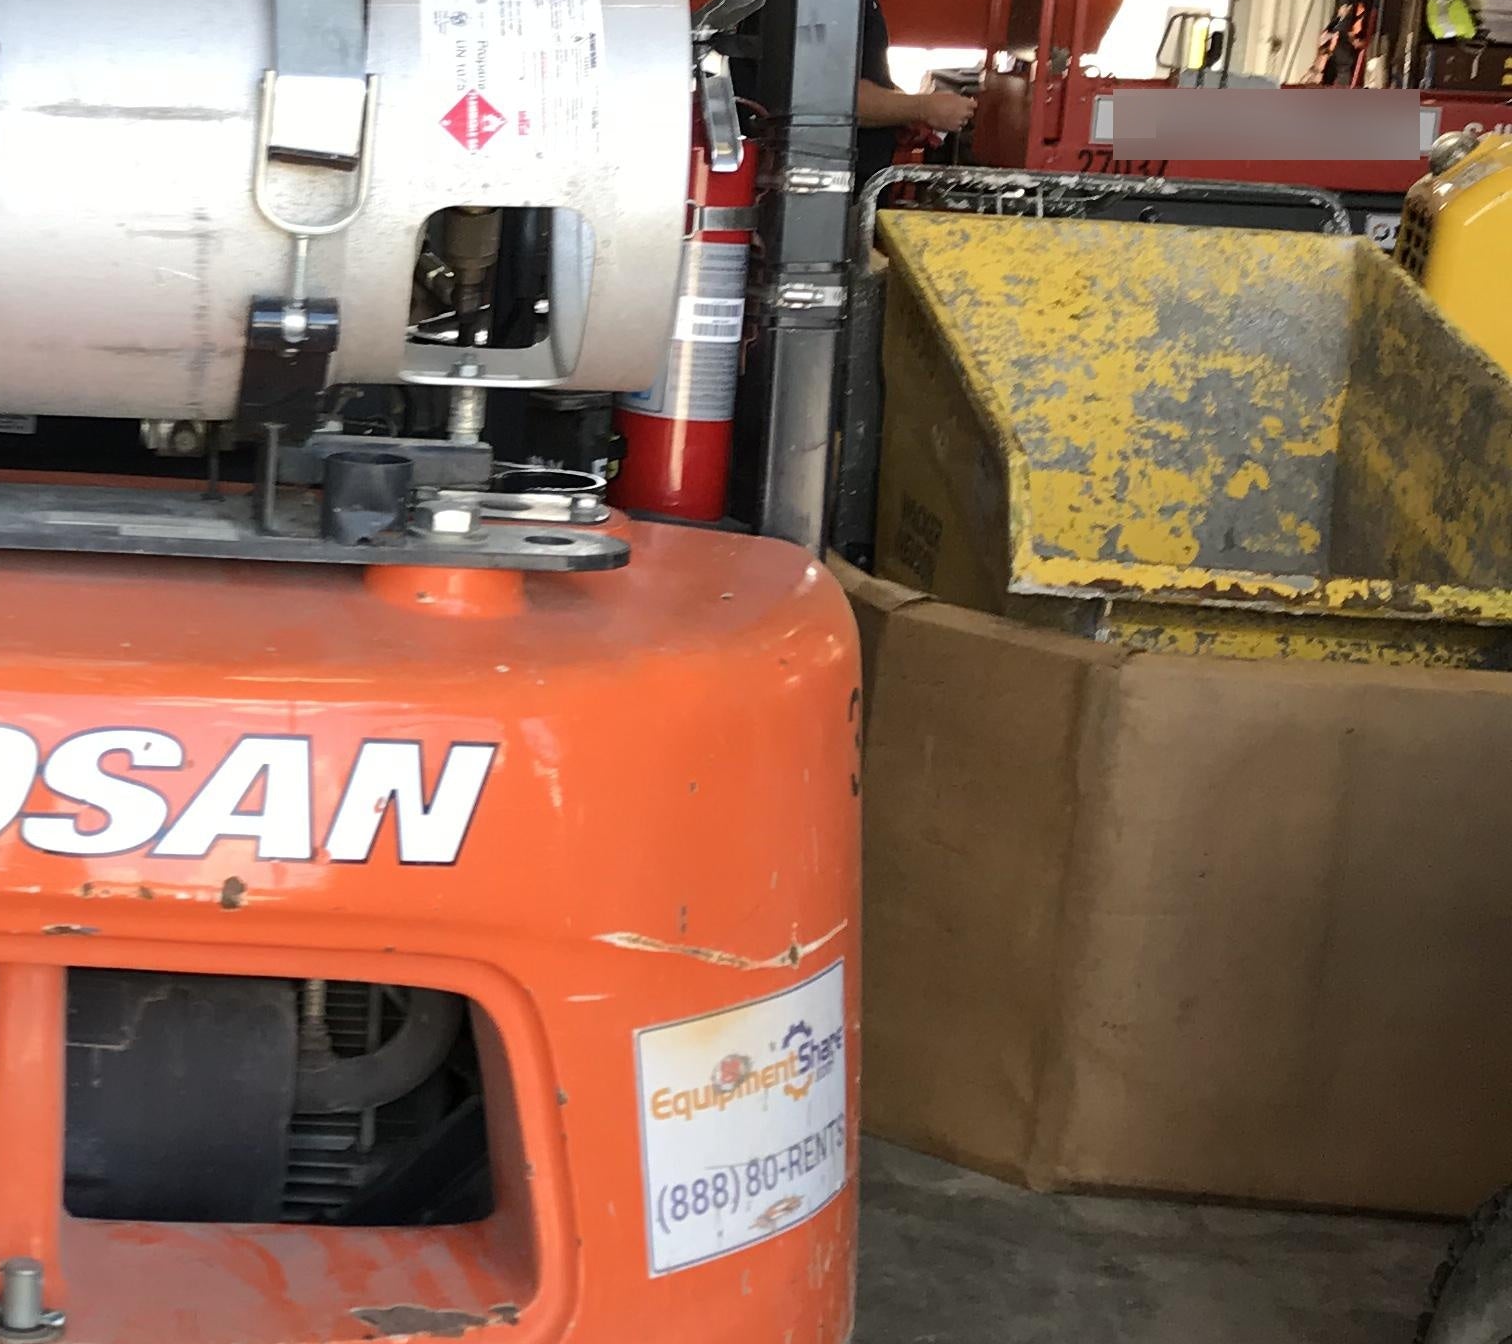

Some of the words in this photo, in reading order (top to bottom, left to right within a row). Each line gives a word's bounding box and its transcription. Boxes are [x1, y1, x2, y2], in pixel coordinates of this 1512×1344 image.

[650, 1026, 844, 1122] EquipmentShare
[654, 1162, 740, 1235] (888)
[744, 1111, 845, 1198] 80-RENTS
